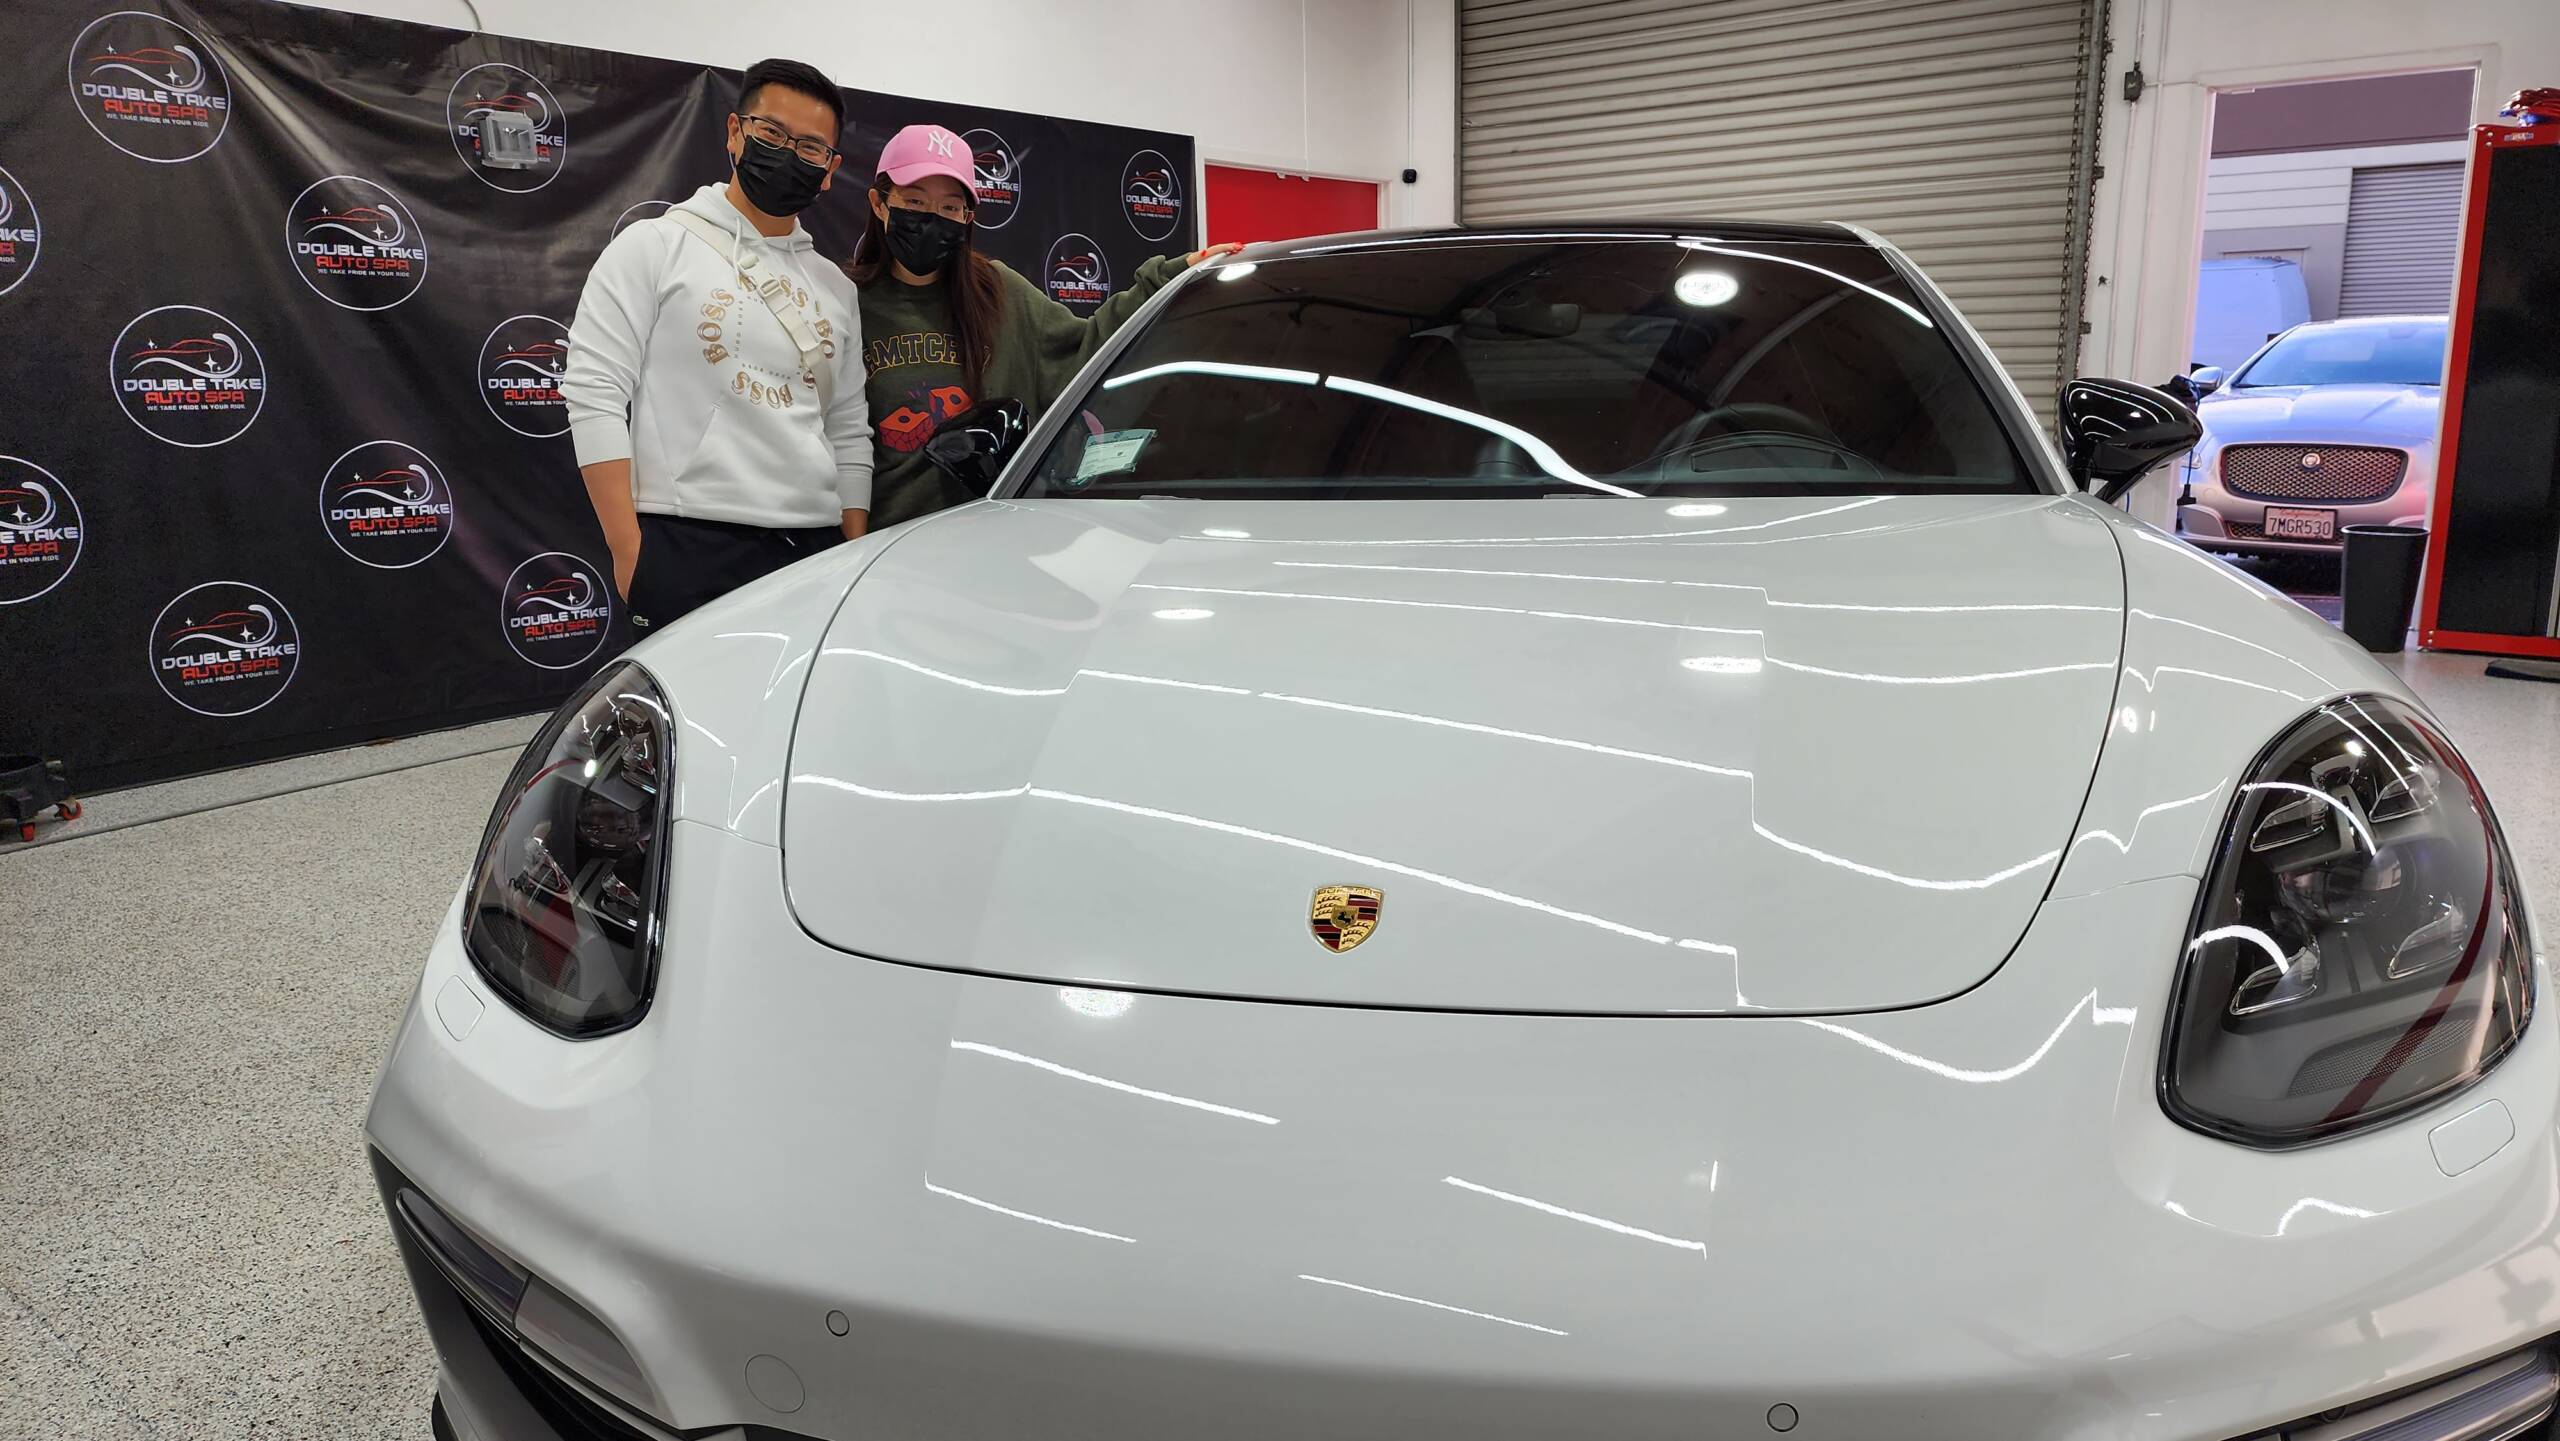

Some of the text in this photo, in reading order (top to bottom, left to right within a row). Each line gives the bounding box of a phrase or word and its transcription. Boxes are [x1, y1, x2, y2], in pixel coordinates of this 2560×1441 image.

[82, 83, 226, 109] DOUBLE TAKE
[104, 99, 208, 120] AUTO SPA
[535, 134, 564, 146] AKE
[927, 130, 953, 160] NY
[974, 180, 1019, 191] BLE TAKE
[1126, 195, 1180, 207] DOUBLE TAKE
[1134, 204, 1155, 212] AUTO
[0, 228, 36, 241] KE
[298, 243, 424, 259] DOUBLE TAKE
[316, 256, 409, 270] AUTO SPA
[1050, 281, 1109, 290] DOUBLE TAKE
[1058, 290, 1081, 298] AUTO
[696, 288, 735, 364] BOSS
[123, 378, 262, 391] DOUBLE TAKE
[488, 379, 551, 388] DOUBLE
[145, 391, 244, 404] AUTO SPA
[504, 390, 545, 399] AUTO
[331, 504, 450, 520] DOUBLE TAKE
[350, 516, 437, 530] AUTO SPA
[2269, 517, 2331, 536] 7MGR530
[19, 527, 78, 542] TAKE
[13, 542, 58, 556] SPA
[511, 607, 608, 628] DOUBLE TAKE
[525, 619, 596, 636] AUTO SPA
[162, 644, 296, 670] DOUBLE TAKE
[182, 658, 279, 679] AUTO SPA
